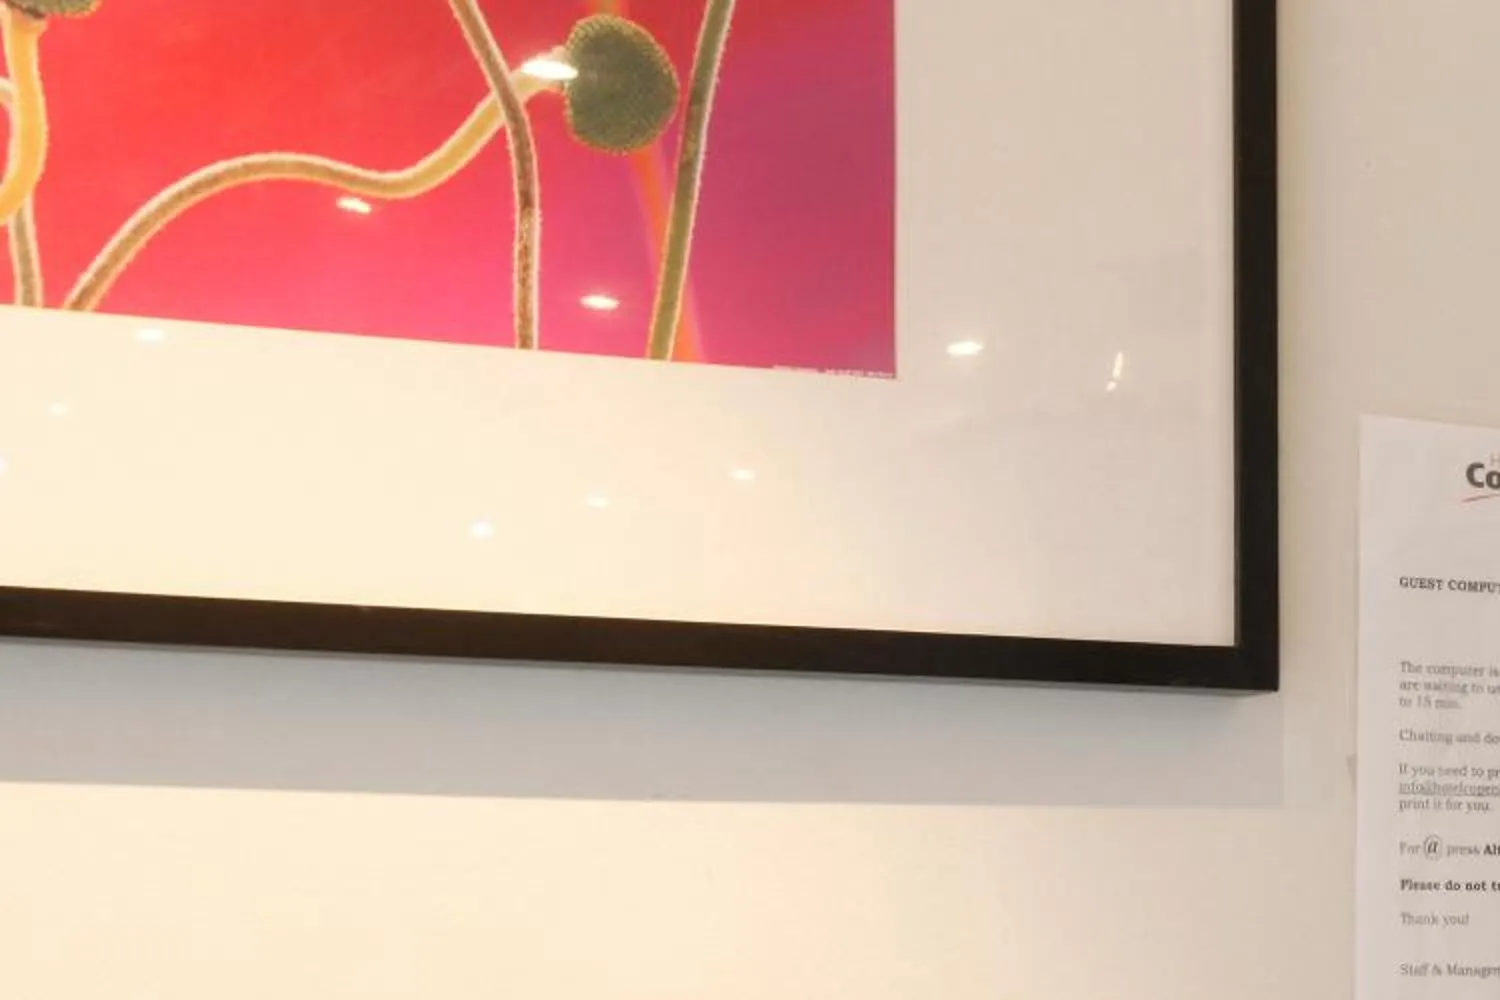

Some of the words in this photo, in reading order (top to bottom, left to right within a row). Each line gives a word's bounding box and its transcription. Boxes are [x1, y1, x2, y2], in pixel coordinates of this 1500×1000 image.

[1400, 576, 1443, 592] GUEST
[1400, 660, 1423, 674] The
[1426, 664, 1485, 679] computer
[1489, 666, 1500, 677] is
[1400, 680, 1420, 691] are
[1423, 681, 1468, 696] waiting
[1471, 683, 1485, 694] to
[1400, 697, 1412, 708] to
[1400, 728, 1453, 745] Chatting
[1456, 731, 1481, 743] and
[1399, 763, 1407, 775] If
[1411, 766, 1435, 778] you
[1438, 766, 1467, 777] need
[1471, 767, 1485, 777] to
[1399, 798, 1430, 812] print
[1433, 799, 1442, 810] it
[1445, 798, 1463, 810] for
[1400, 841, 1421, 856] For
[1446, 844, 1479, 859] press
[1400, 878, 1441, 892] Please
[1445, 879, 1461, 892] do
[1465, 880, 1487, 892] not
[1400, 912, 1438, 926] Thank
[1442, 912, 1470, 928] you!
[1400, 963, 1428, 977] Staff
